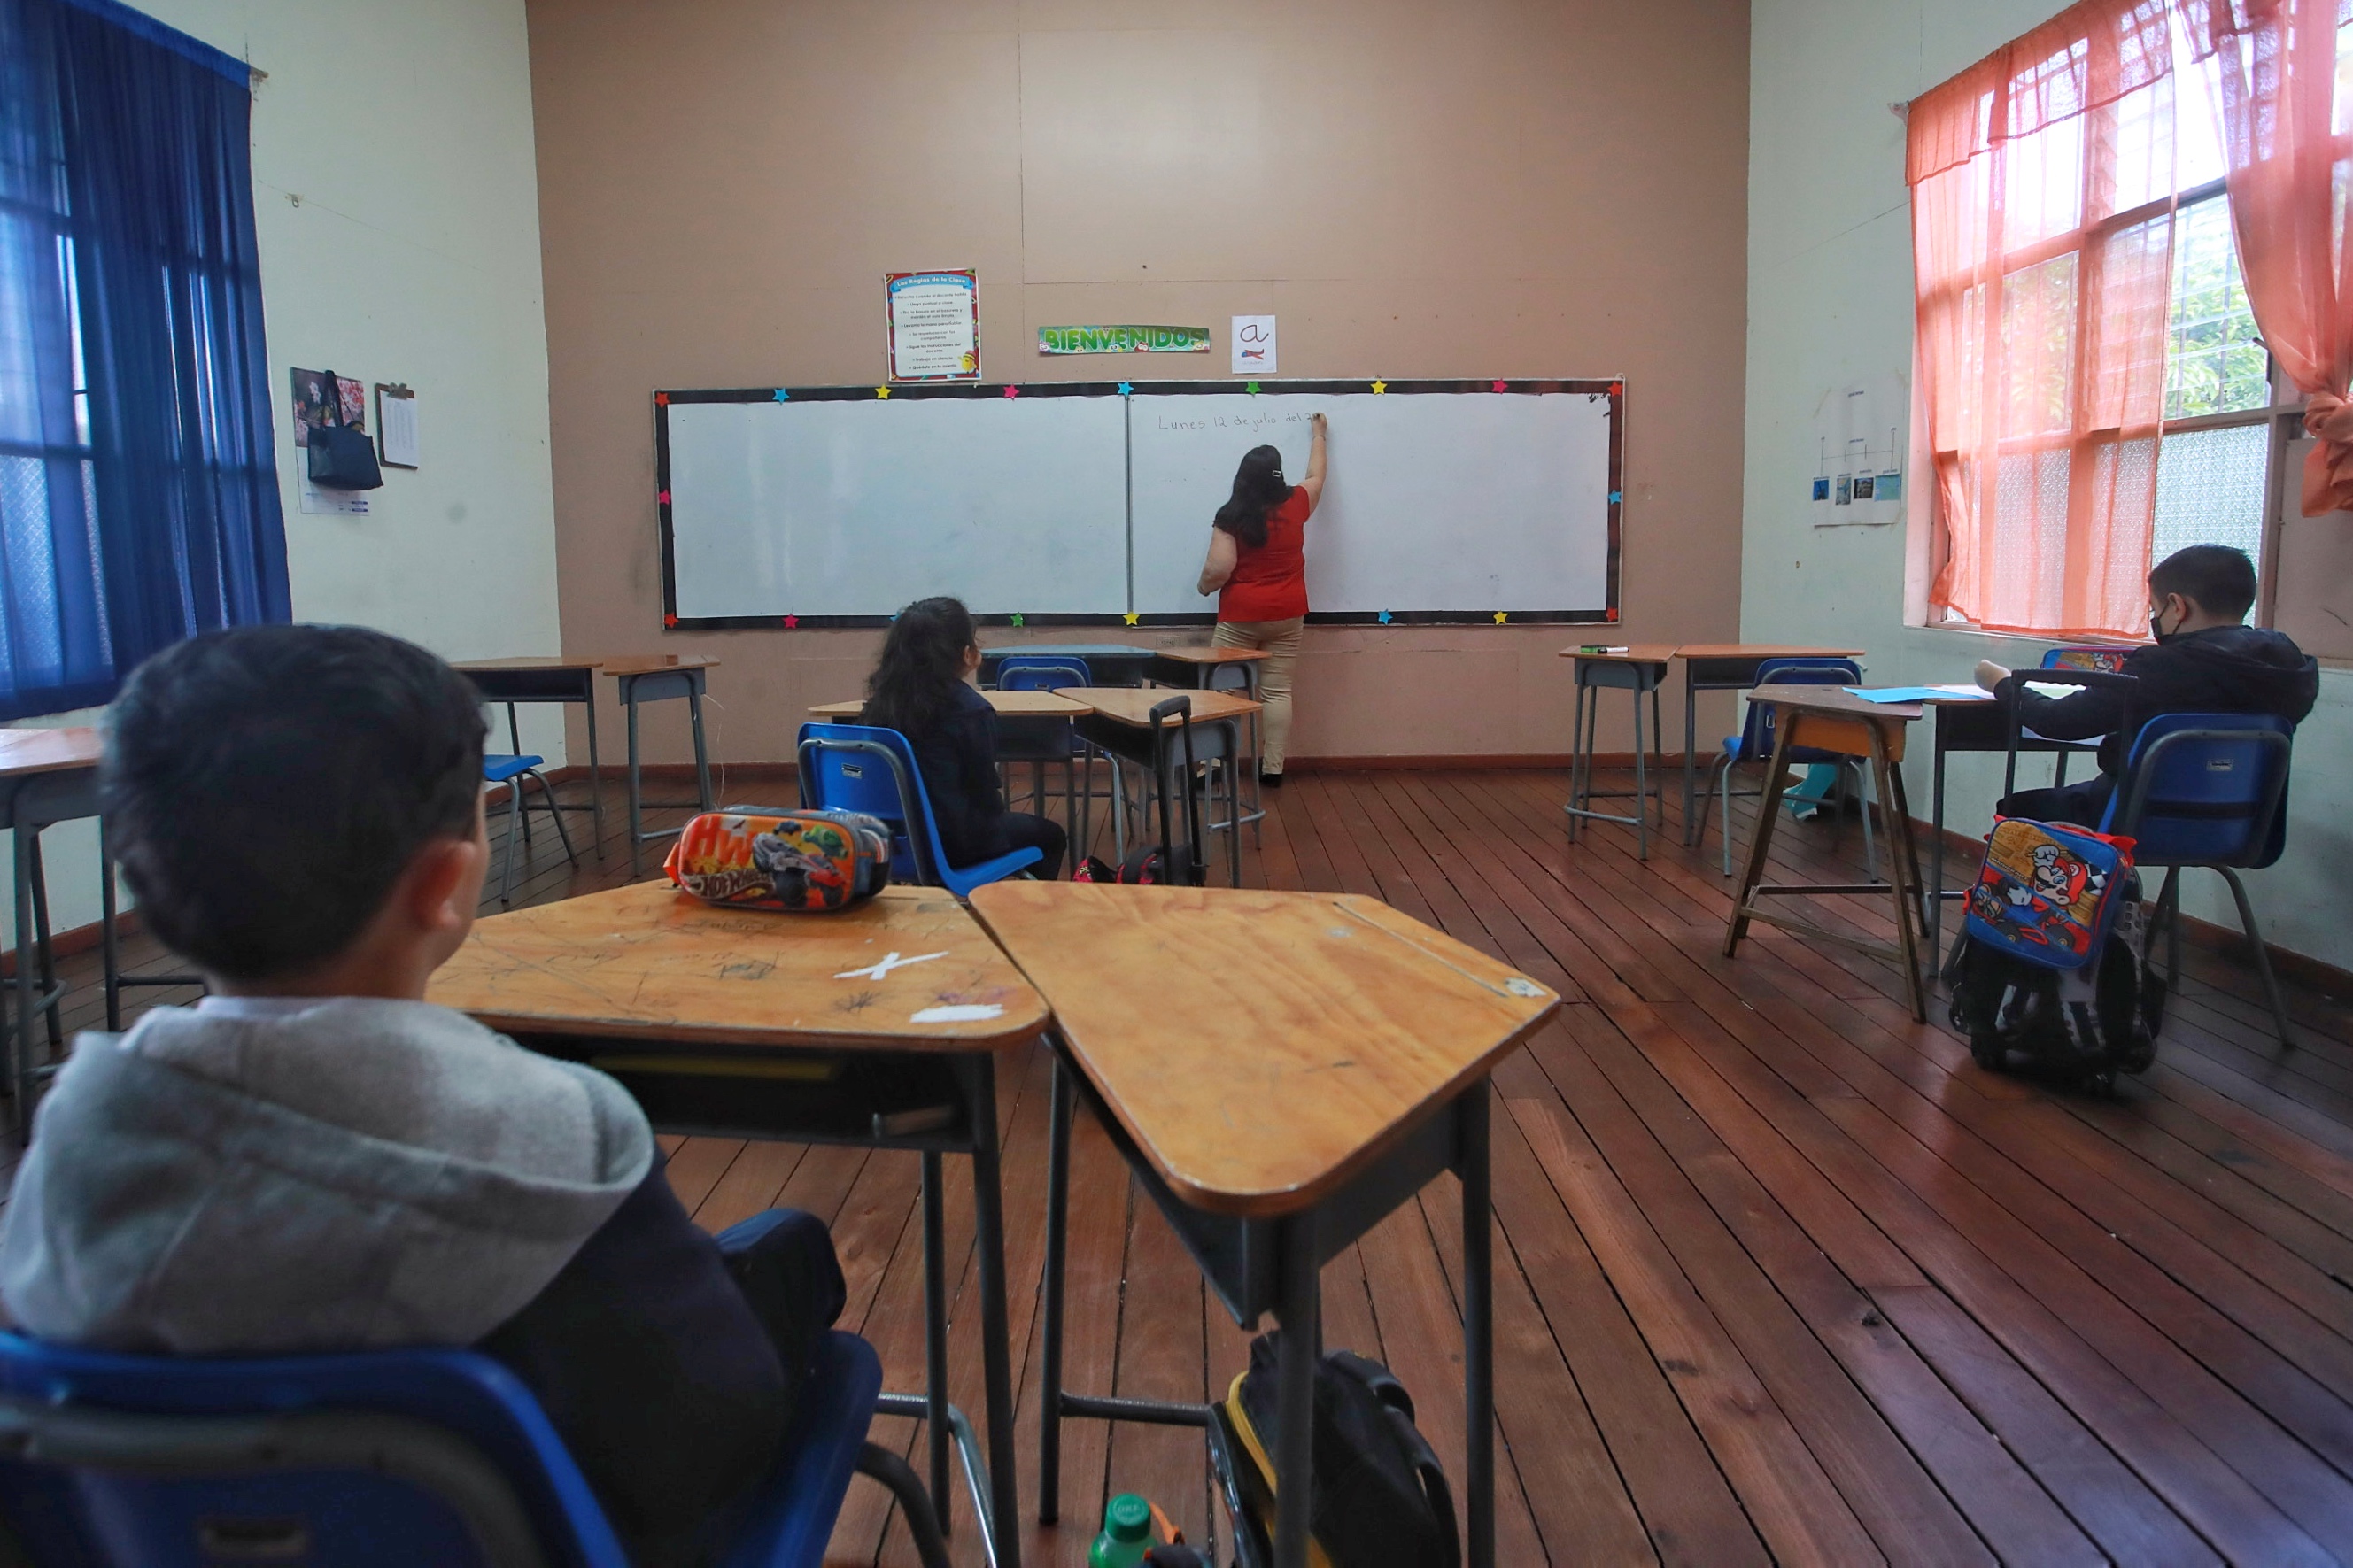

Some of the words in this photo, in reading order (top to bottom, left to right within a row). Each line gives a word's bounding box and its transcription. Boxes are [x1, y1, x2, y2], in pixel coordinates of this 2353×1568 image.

[1044, 328, 1205, 351] BIENVENIDOS
[1240, 324, 1269, 343] a
[1158, 415, 1206, 430] Lunes
[1213, 416, 1227, 428] 12
[1233, 414, 1248, 426] de
[1249, 413, 1277, 432] julio
[1286, 413, 1302, 422] del
